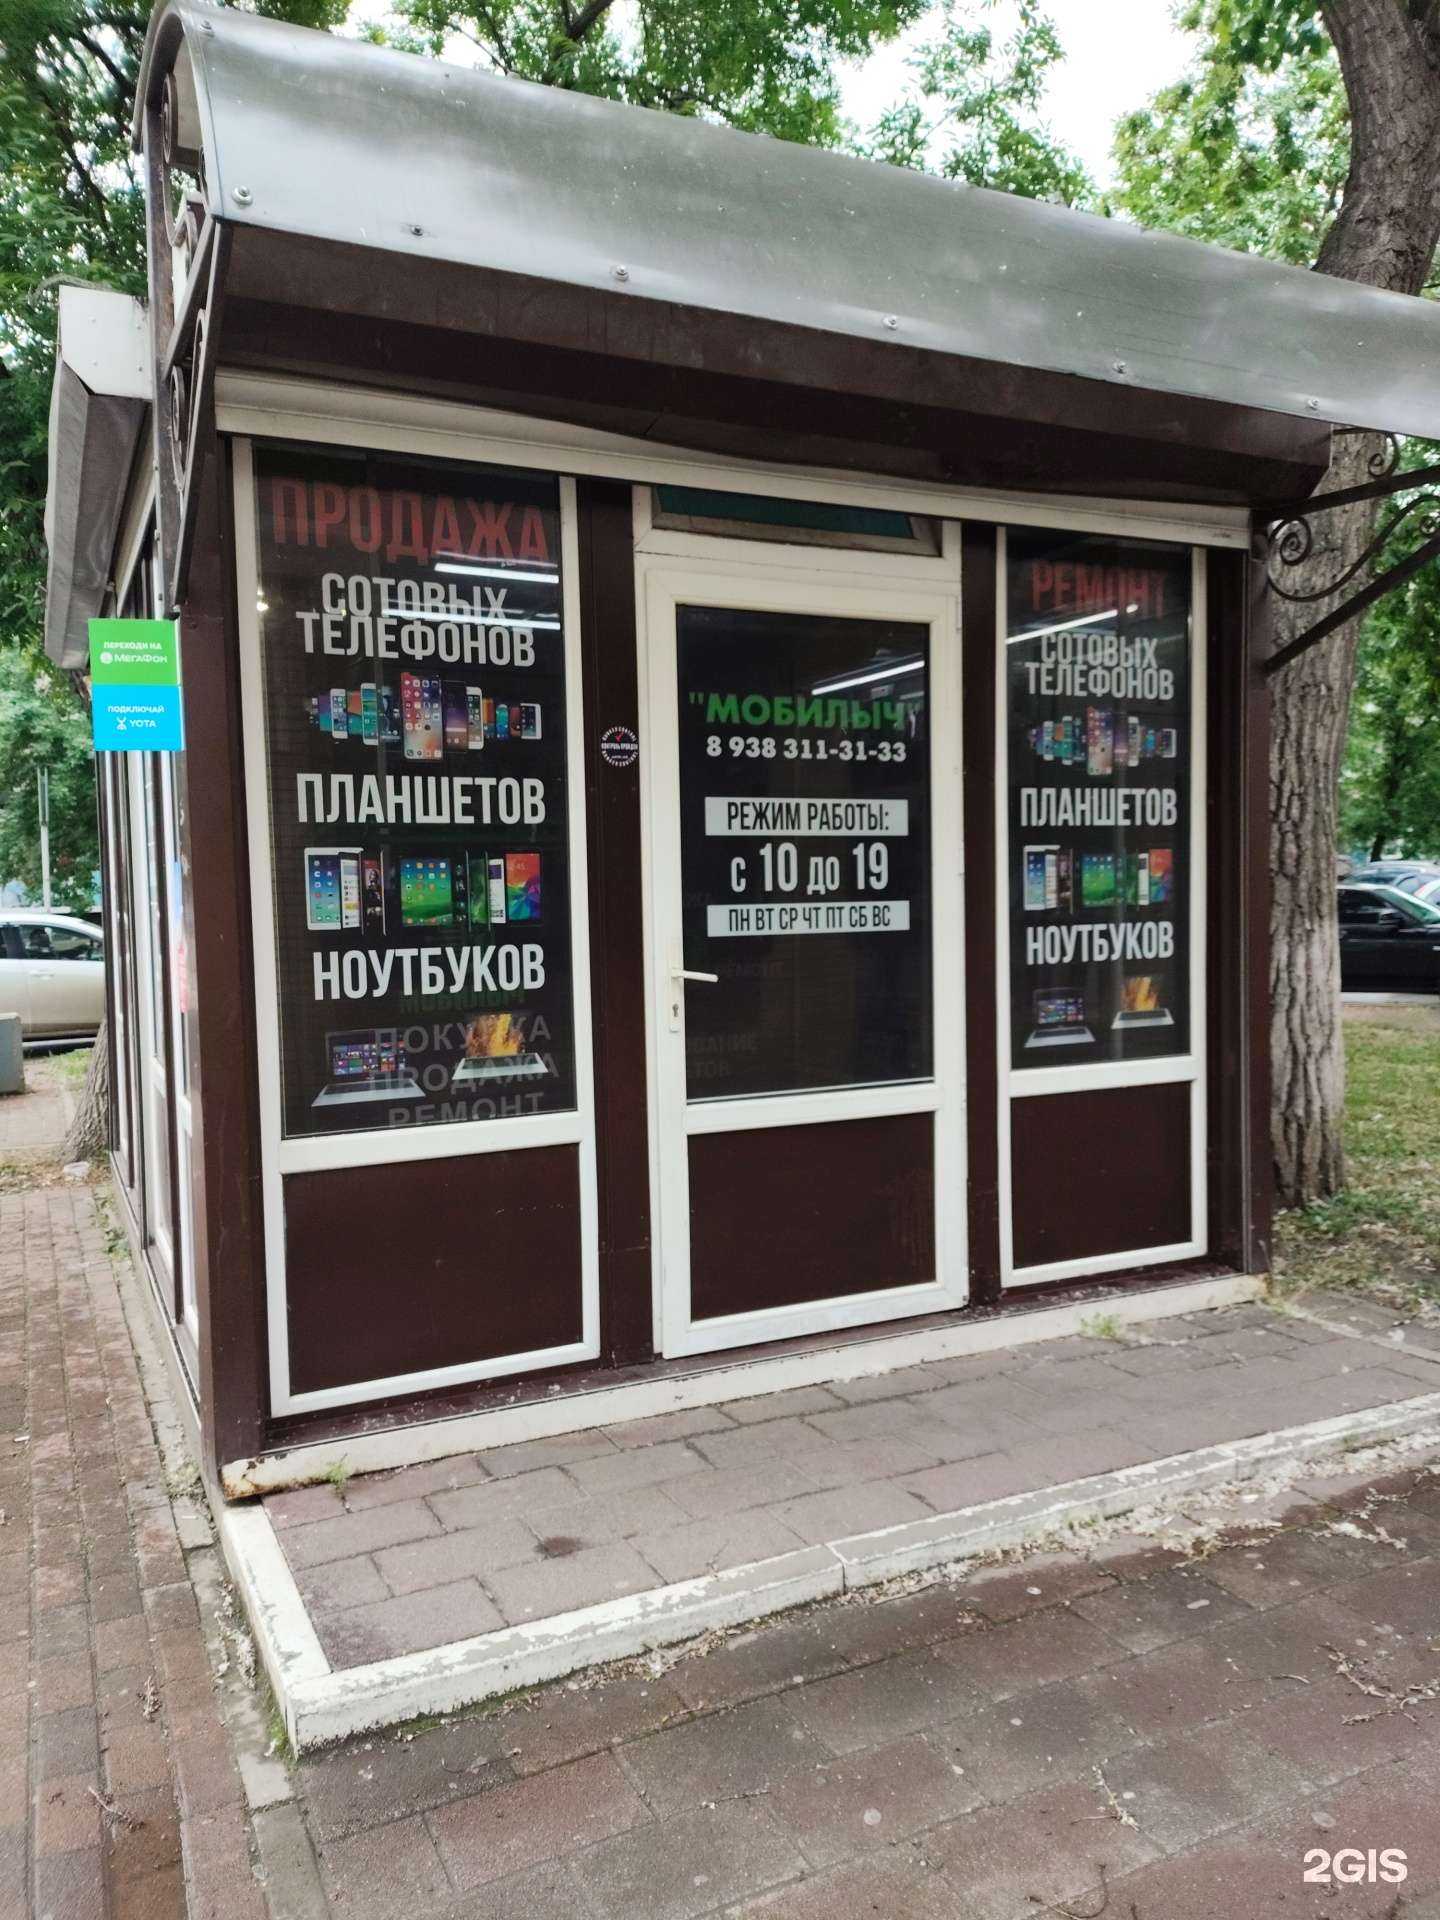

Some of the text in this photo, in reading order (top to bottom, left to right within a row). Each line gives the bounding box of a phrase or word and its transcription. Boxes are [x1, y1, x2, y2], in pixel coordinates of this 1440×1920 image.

[271, 475, 550, 565] ПРОДАЖА
[321, 573, 508, 622] СОТОВЫХ
[1032, 561, 1168, 621] РЕМОНТ
[103, 641, 162, 651] ПЕРЕХОДИ НА
[296, 610, 536, 667] ТЕЛЕФОНОВ
[1041, 632, 1158, 669] СОТОВЫХ
[1025, 661, 1175, 700] ТЕЛЕФОНОВ
[107, 704, 165, 714] ПОДКЛЮЧАЙ
[129, 718, 157, 728] YOTA
[706, 735, 907, 762] 8 938 311-31-33
[296, 772, 546, 825] ПЛАНШЕТОВ
[727, 801, 889, 830] РЕЖИМ РАБОТЫ:
[1020, 788, 1178, 827] ПЛАНШЕТОВ
[759, 842, 798, 892] 10
[853, 842, 889, 890] 19
[729, 905, 891, 932] ПН ВТ СР ЧТ ПТ СБ ВС
[1026, 920, 1175, 966] НОУТБУКОВ
[312, 943, 546, 1001] НОУТБУКОВ
[375, 1014, 552, 1054] ПОКУКА
[387, 1091, 545, 1129] РЕМОНТ
